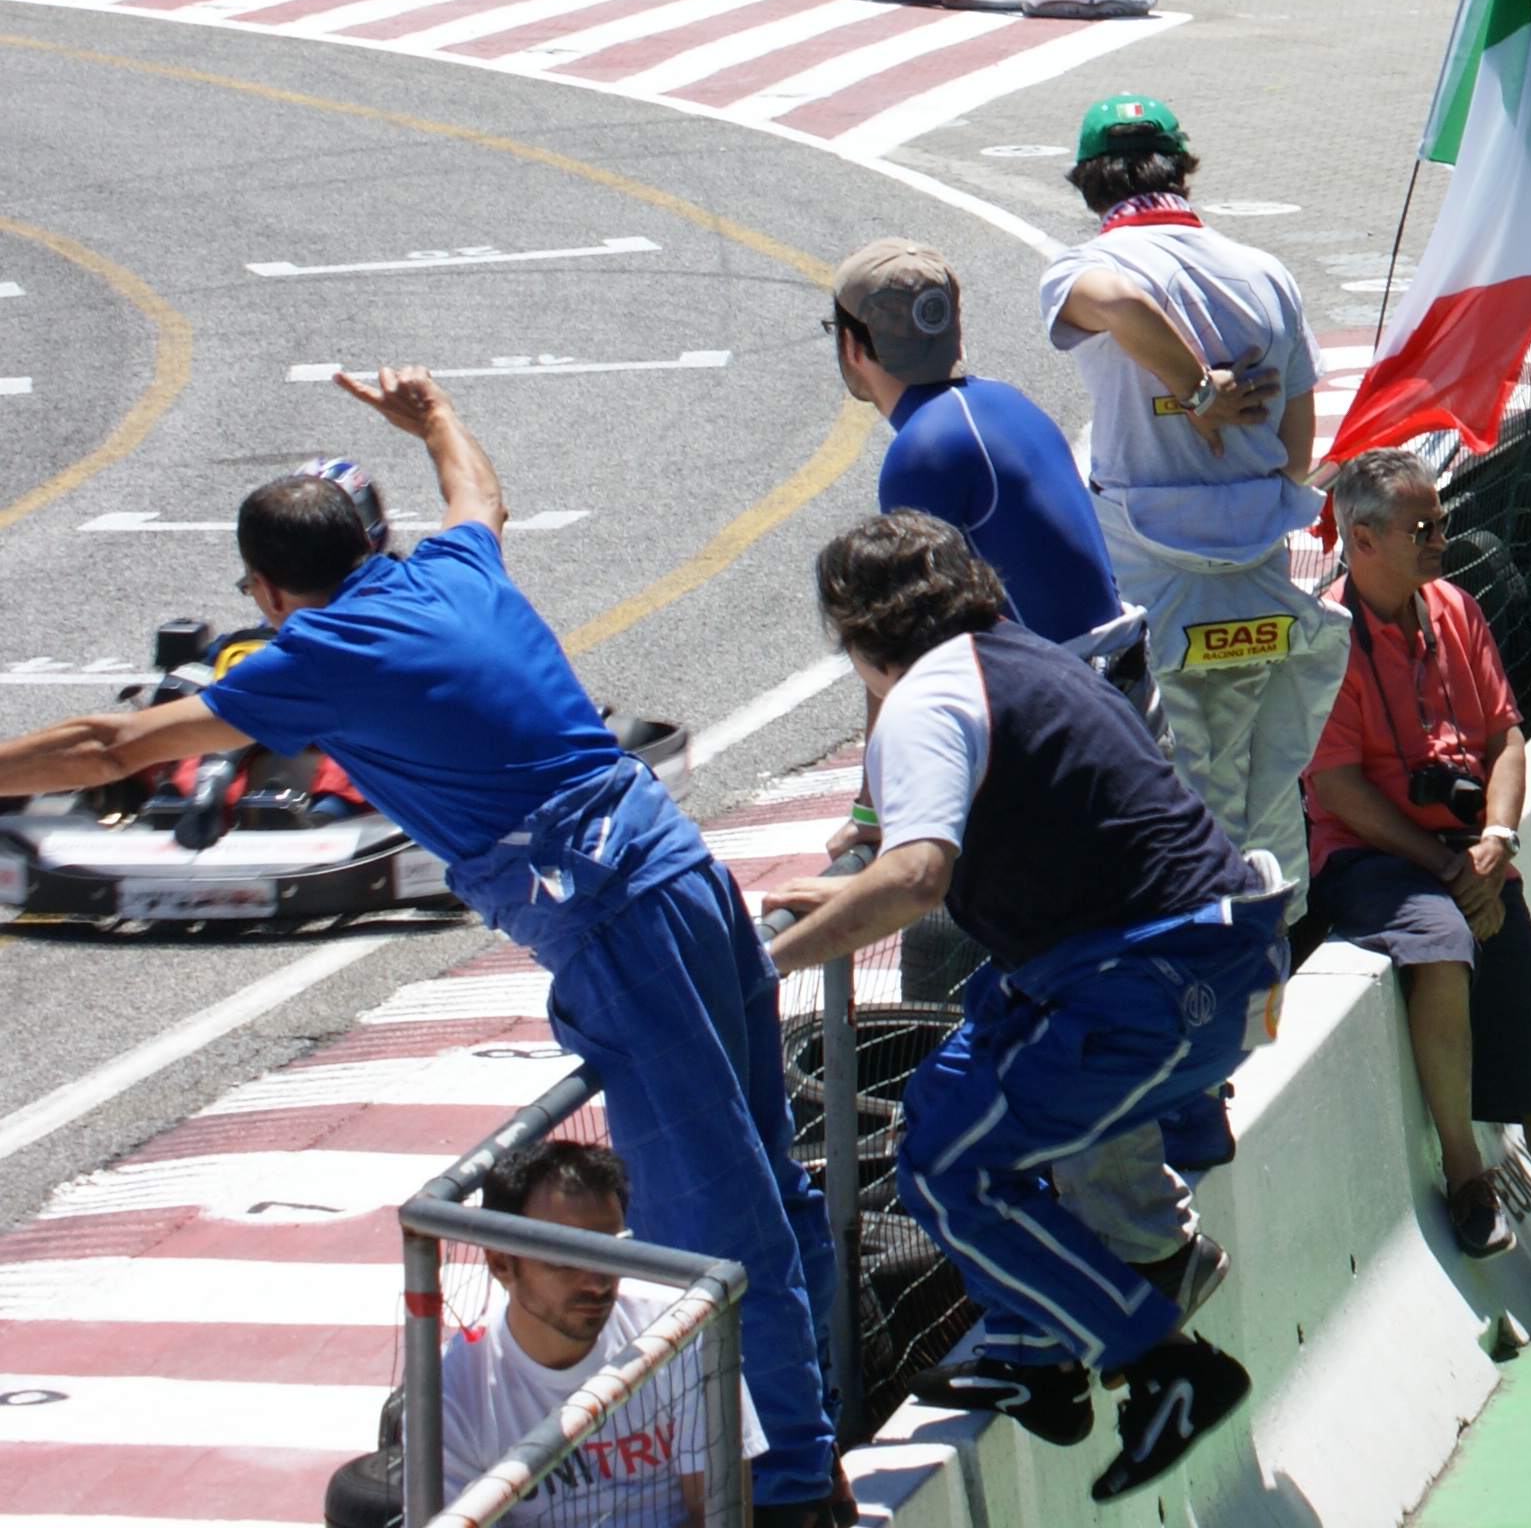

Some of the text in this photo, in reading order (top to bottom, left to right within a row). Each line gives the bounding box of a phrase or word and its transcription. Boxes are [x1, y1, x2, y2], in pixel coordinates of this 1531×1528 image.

[1204, 621, 1279, 651] GAS
[1202, 643, 1278, 662] RACING TEAM
